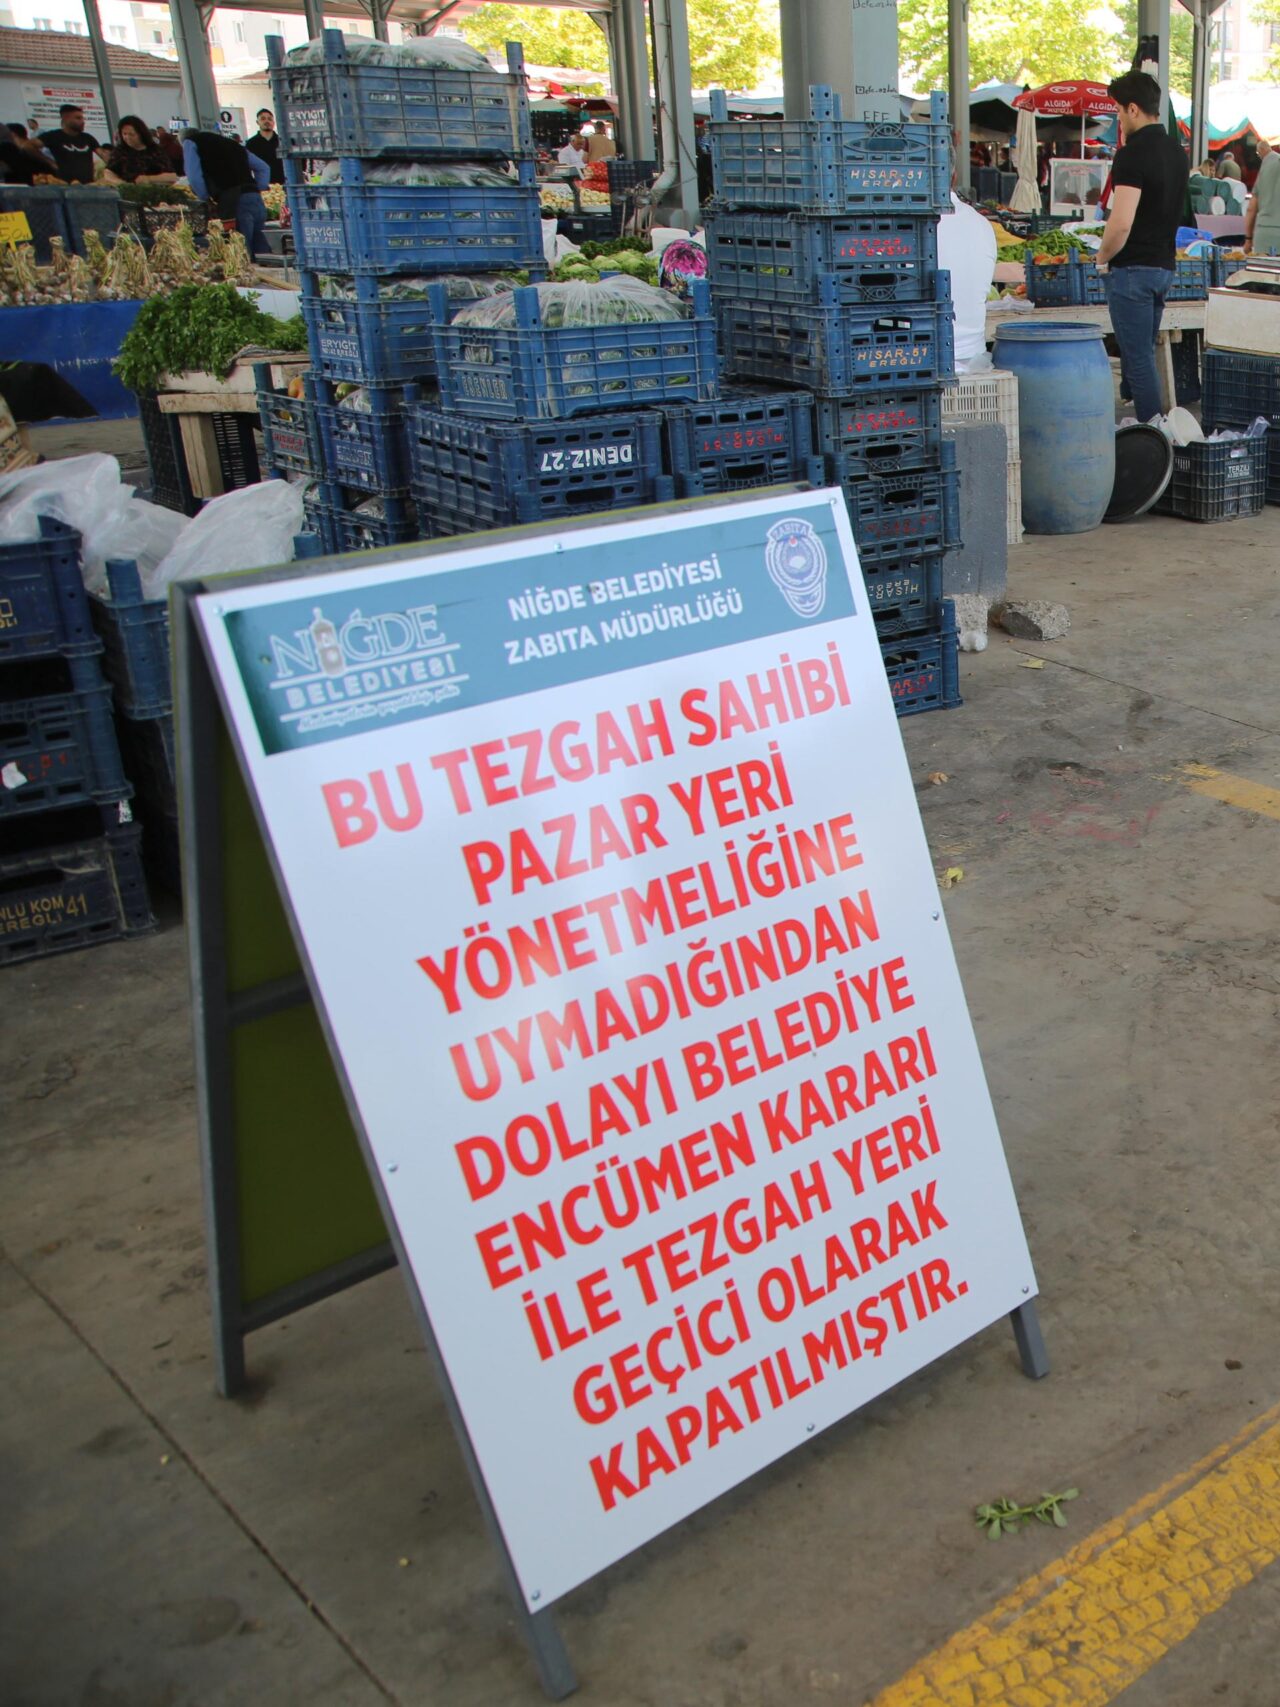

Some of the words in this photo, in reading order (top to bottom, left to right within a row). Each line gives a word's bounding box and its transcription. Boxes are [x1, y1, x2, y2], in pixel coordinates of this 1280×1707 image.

[504, 624, 599, 666] ZABITA
[600, 589, 745, 644] MÜDÜRLÜĞÜ
[507, 580, 586, 624] NİĞDE
[588, 552, 724, 607] BELEDİYESİ
[320, 761, 425, 850] BU
[430, 697, 676, 818] TEZGAH
[679, 641, 852, 749] SAHİBİ
[461, 792, 668, 907] PAZAR
[668, 740, 795, 837] YERİ
[417, 811, 864, 1016] YÖNETMELİĞİNE
[449, 889, 880, 1103] UYMADIĞINDAN
[453, 1058, 679, 1203] DOLAYI
[680, 955, 917, 1103] BELEDİYE
[473, 1111, 756, 1291] ENCÜMEN
[758, 1026, 939, 1154] KARARI
[521, 1266, 622, 1362] İLE
[621, 1160, 833, 1307] TEZGAH
[832, 1093, 942, 1197] YERİ
[572, 1278, 752, 1426] GEÇİCİ
[756, 1180, 949, 1324] OLARAK
[588, 1257, 970, 1513] KAPATILMIŞTIR.
